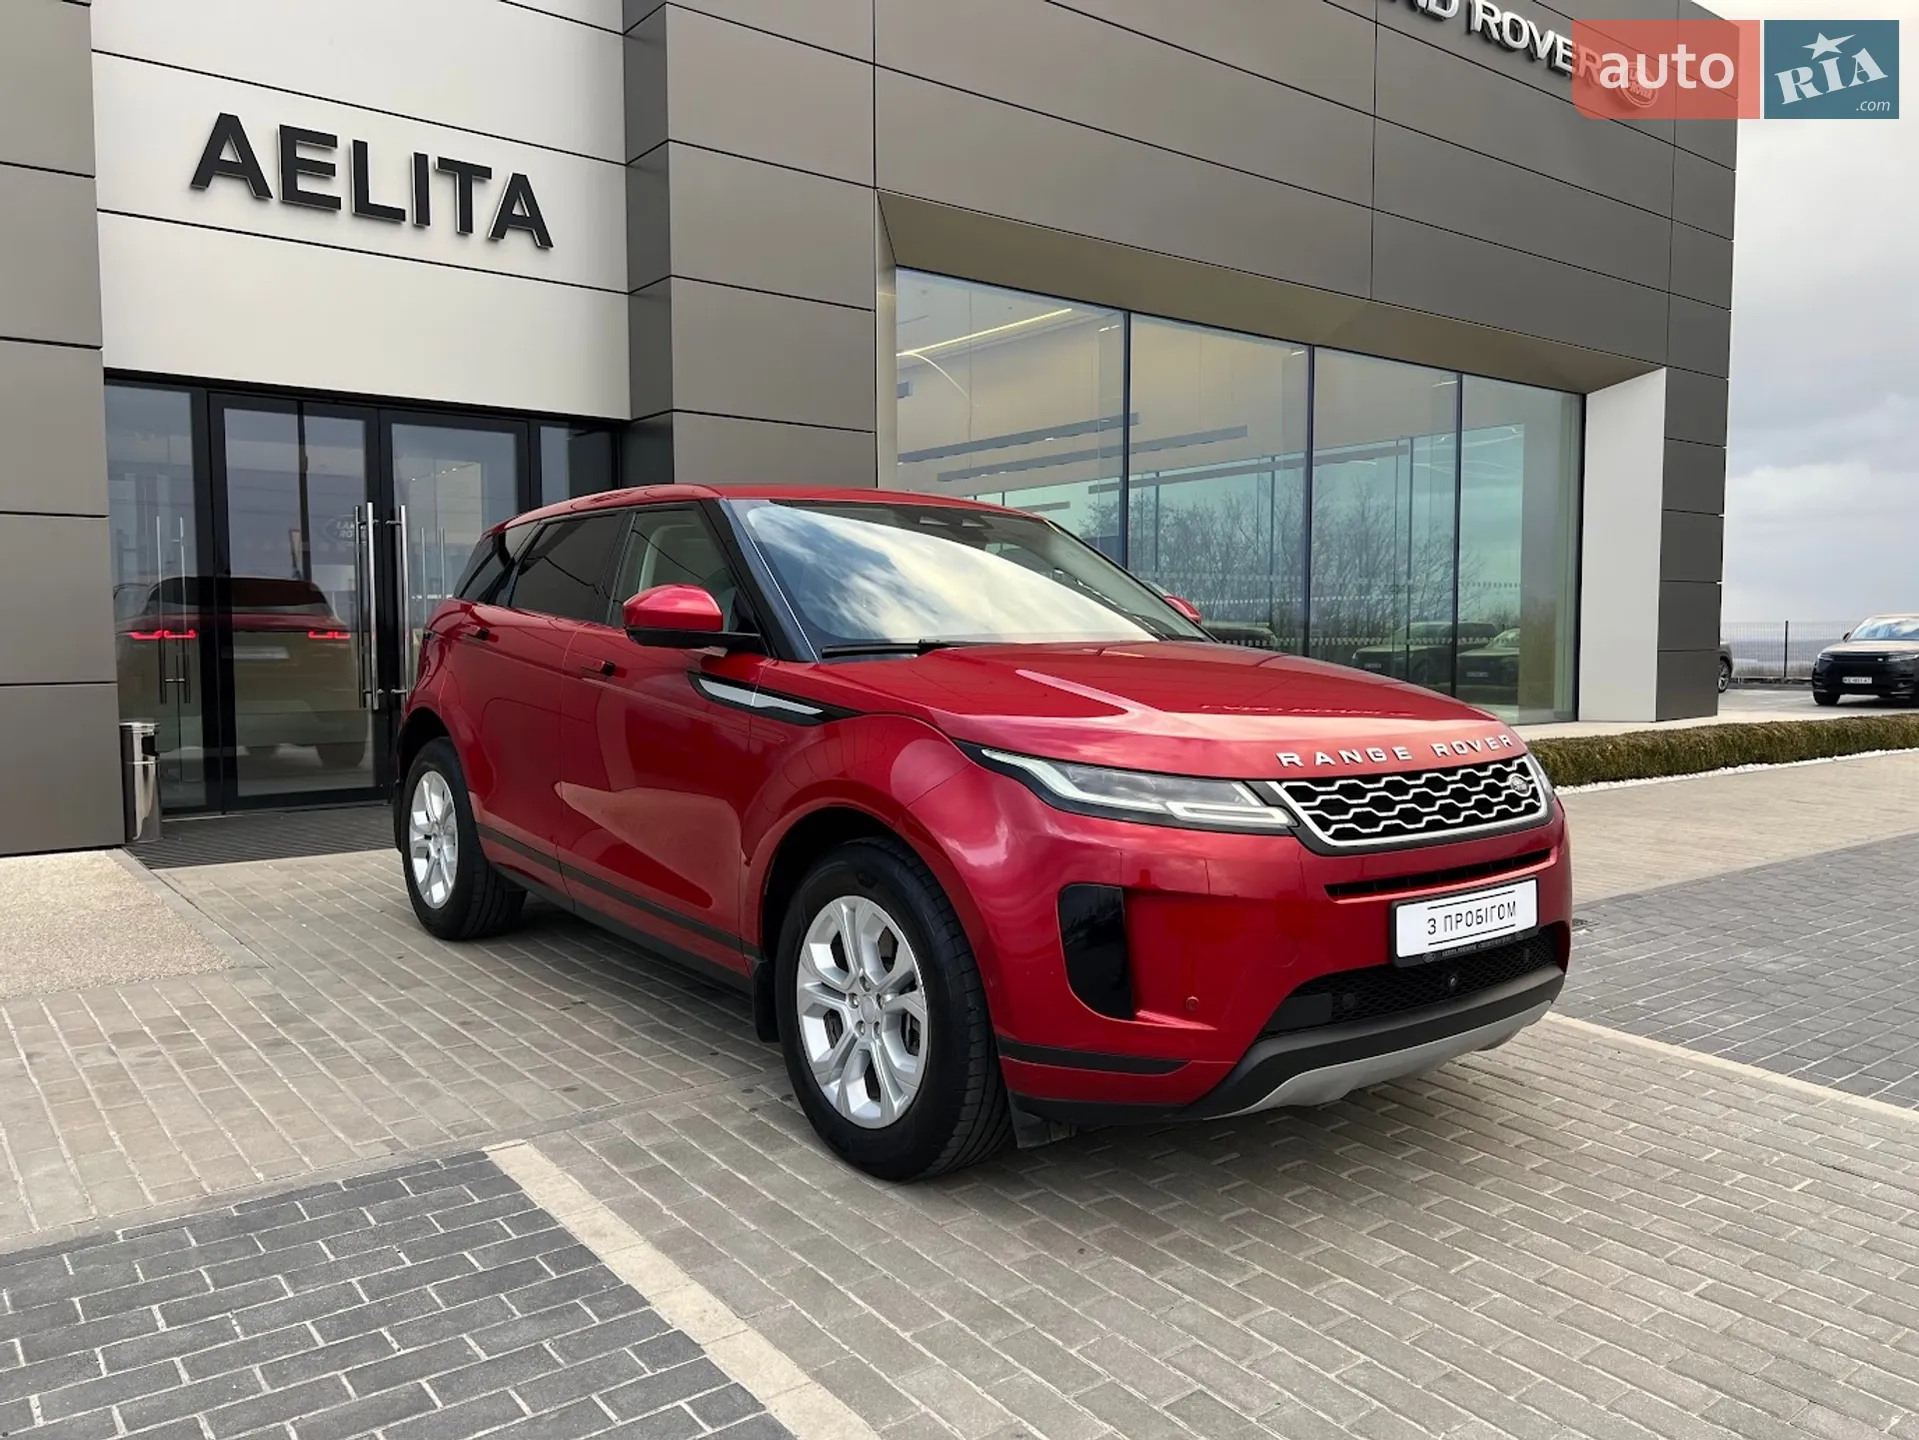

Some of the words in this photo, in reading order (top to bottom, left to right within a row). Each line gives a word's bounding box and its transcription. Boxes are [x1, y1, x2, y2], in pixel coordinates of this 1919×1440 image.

[1470, 0, 1602, 85] ROVER
[189, 111, 555, 249] AELITA
[1276, 746, 1413, 768] RANGE
[1430, 734, 1514, 758] ROVER
[1427, 917, 1437, 935] З
[1443, 900, 1516, 932] ПРОБІГОМ
